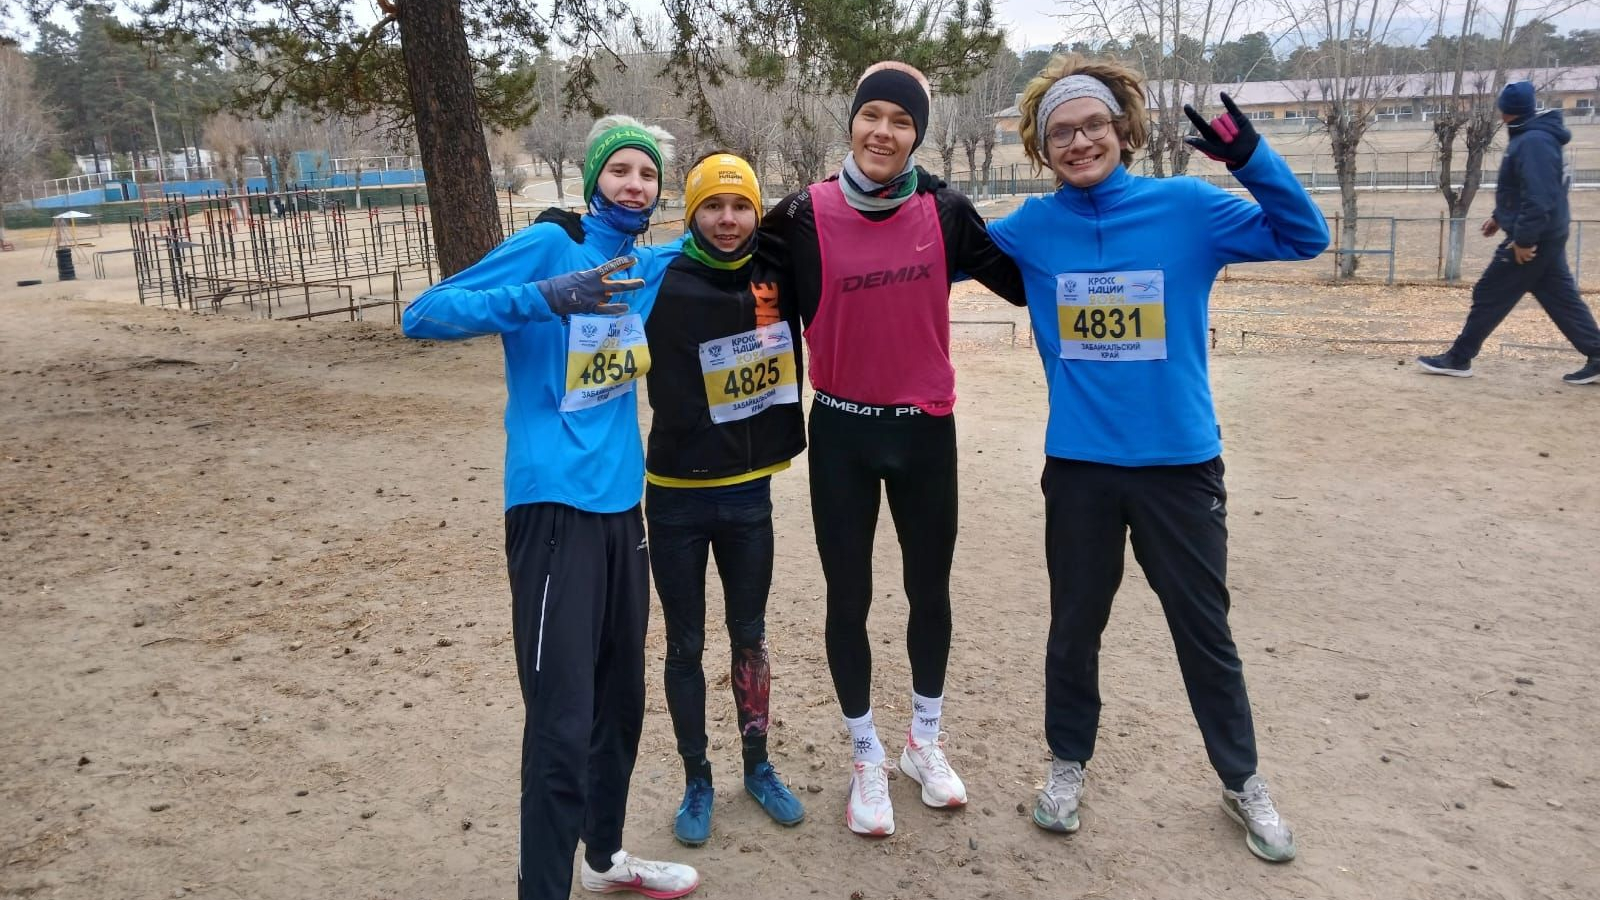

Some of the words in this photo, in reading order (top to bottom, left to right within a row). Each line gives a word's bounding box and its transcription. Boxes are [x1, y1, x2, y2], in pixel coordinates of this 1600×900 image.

[786, 201, 800, 219] JUST
[797, 192, 809, 202] DO
[840, 263, 935, 293] DEMIX
[1088, 276, 1116, 285] КРОСС
[1088, 285, 1124, 294] НАЦИИ
[750, 281, 780, 326] IKE
[1073, 307, 1142, 339] 4831
[731, 333, 756, 347] КРОСС
[733, 341, 764, 355] НАЦИИ
[1081, 342, 1141, 351] ЗАБАЙКАЛЬСКИЙ
[579, 349, 638, 385] 4854
[1100, 351, 1120, 359] КРАЙ
[723, 356, 780, 399] 4825
[732, 388, 776, 411] ЗАБАЙКАЛЬСКИЙ
[815, 391, 885, 417] COMBAT
